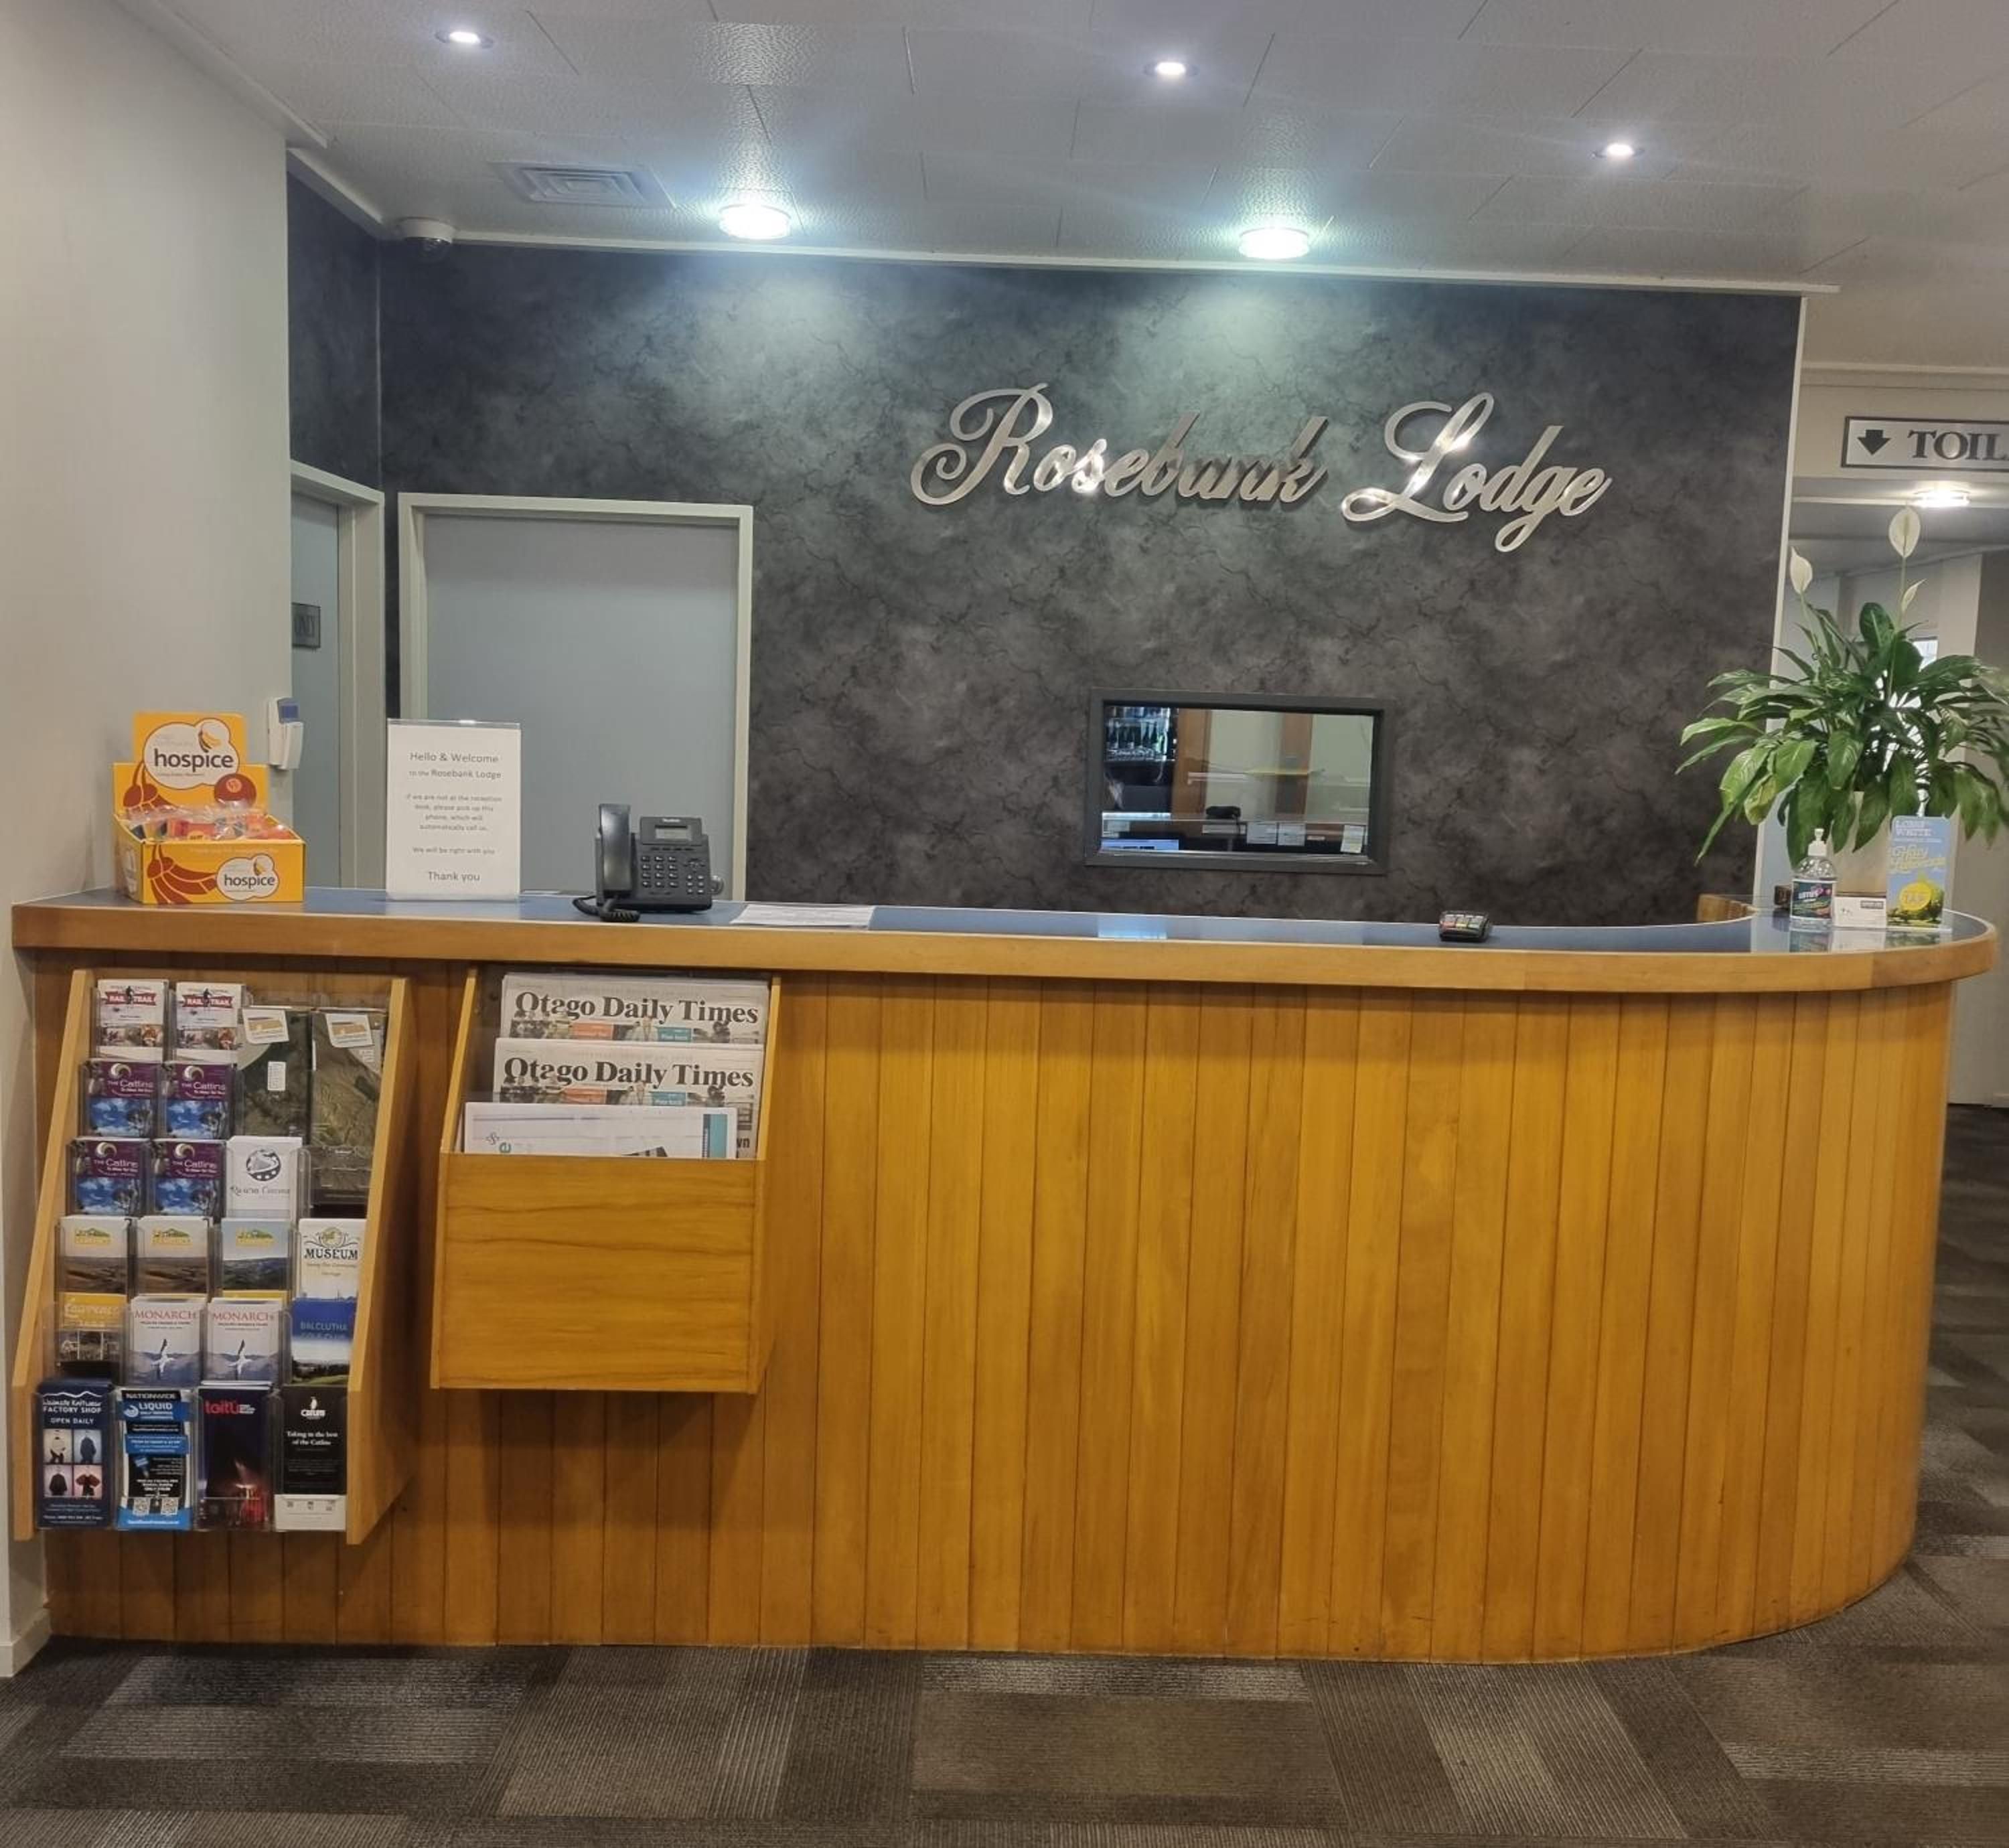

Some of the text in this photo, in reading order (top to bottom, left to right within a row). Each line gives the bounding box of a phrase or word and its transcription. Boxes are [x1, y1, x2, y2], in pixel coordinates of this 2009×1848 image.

[910, 384, 1611, 552] Rosebank Lodge
[154, 749, 234, 772] hospice
[410, 752, 499, 763] Hello & Welcome
[431, 769, 473, 778] Rosebank
[475, 771, 502, 780] Lodge
[224, 874, 275, 889] hospice
[429, 871, 481, 882] Thank you
[514, 990, 759, 1025] Otago Daily Times
[504, 1057, 754, 1089] Otago Daily Times
[120, 1079, 154, 1088] Catlins
[304, 1248, 358, 1260] MUSEUM
[135, 1310, 197, 1319] MONARCH
[213, 1312, 275, 1321] MONARCH
[139, 1402, 173, 1411] LIQUID
